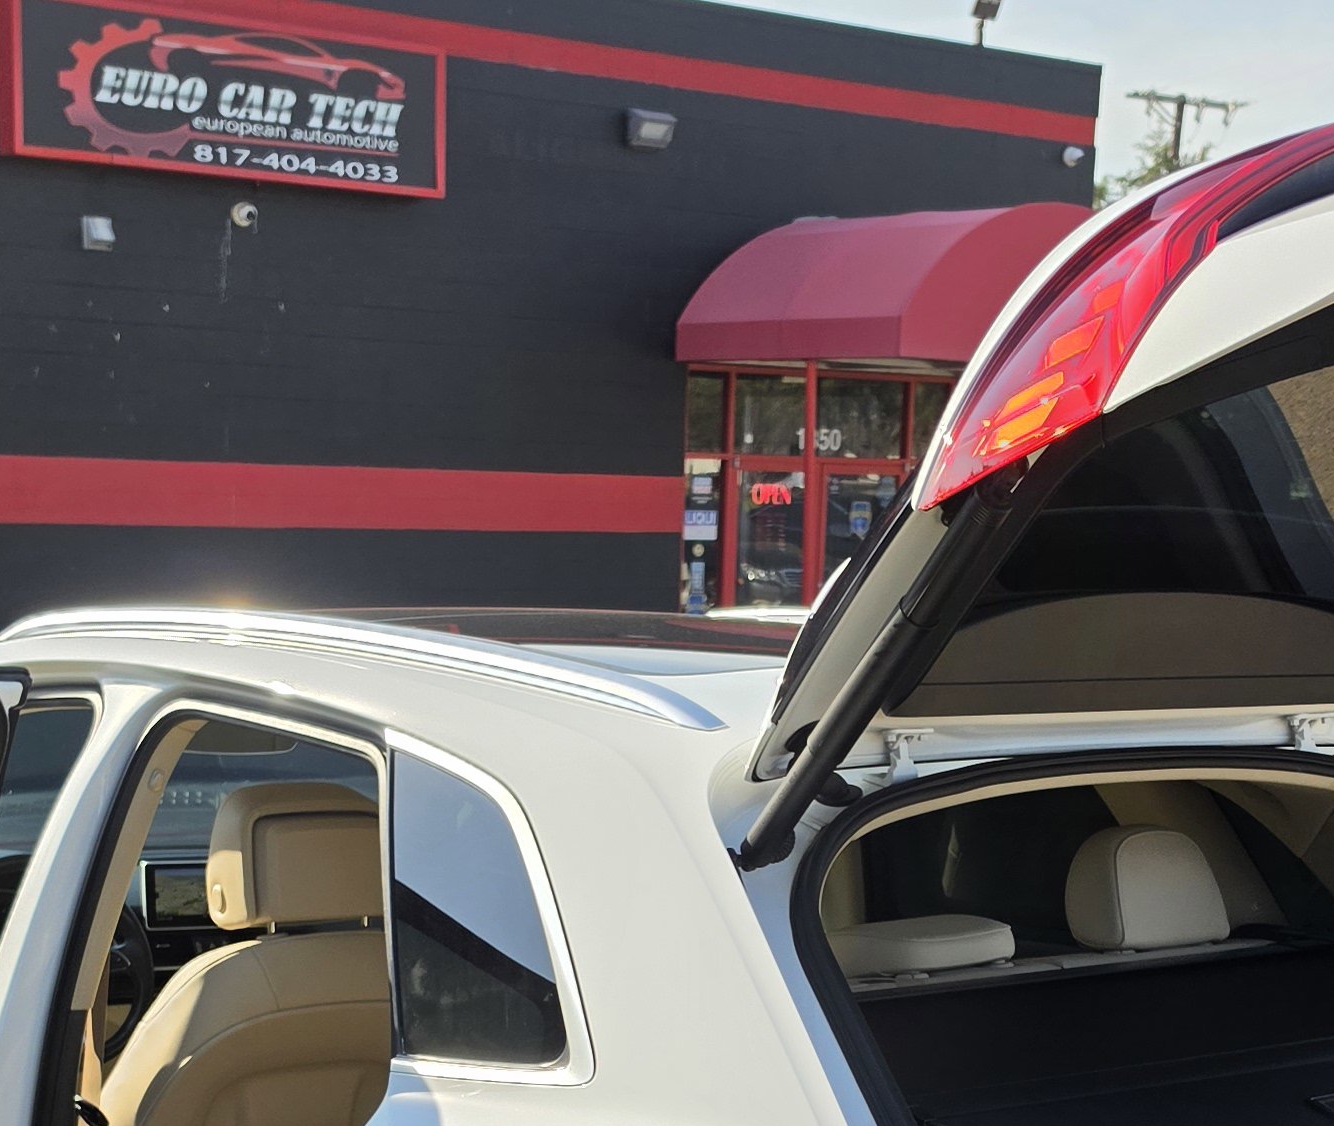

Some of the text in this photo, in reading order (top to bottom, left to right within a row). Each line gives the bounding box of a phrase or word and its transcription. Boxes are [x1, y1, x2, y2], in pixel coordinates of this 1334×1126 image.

[95, 66, 404, 137] EURO CAR TECH
[191, 115, 399, 152] european automotive
[193, 144, 399, 183] 817-404-4033
[795, 427, 842, 451] 150
[751, 483, 792, 505] OPEN
